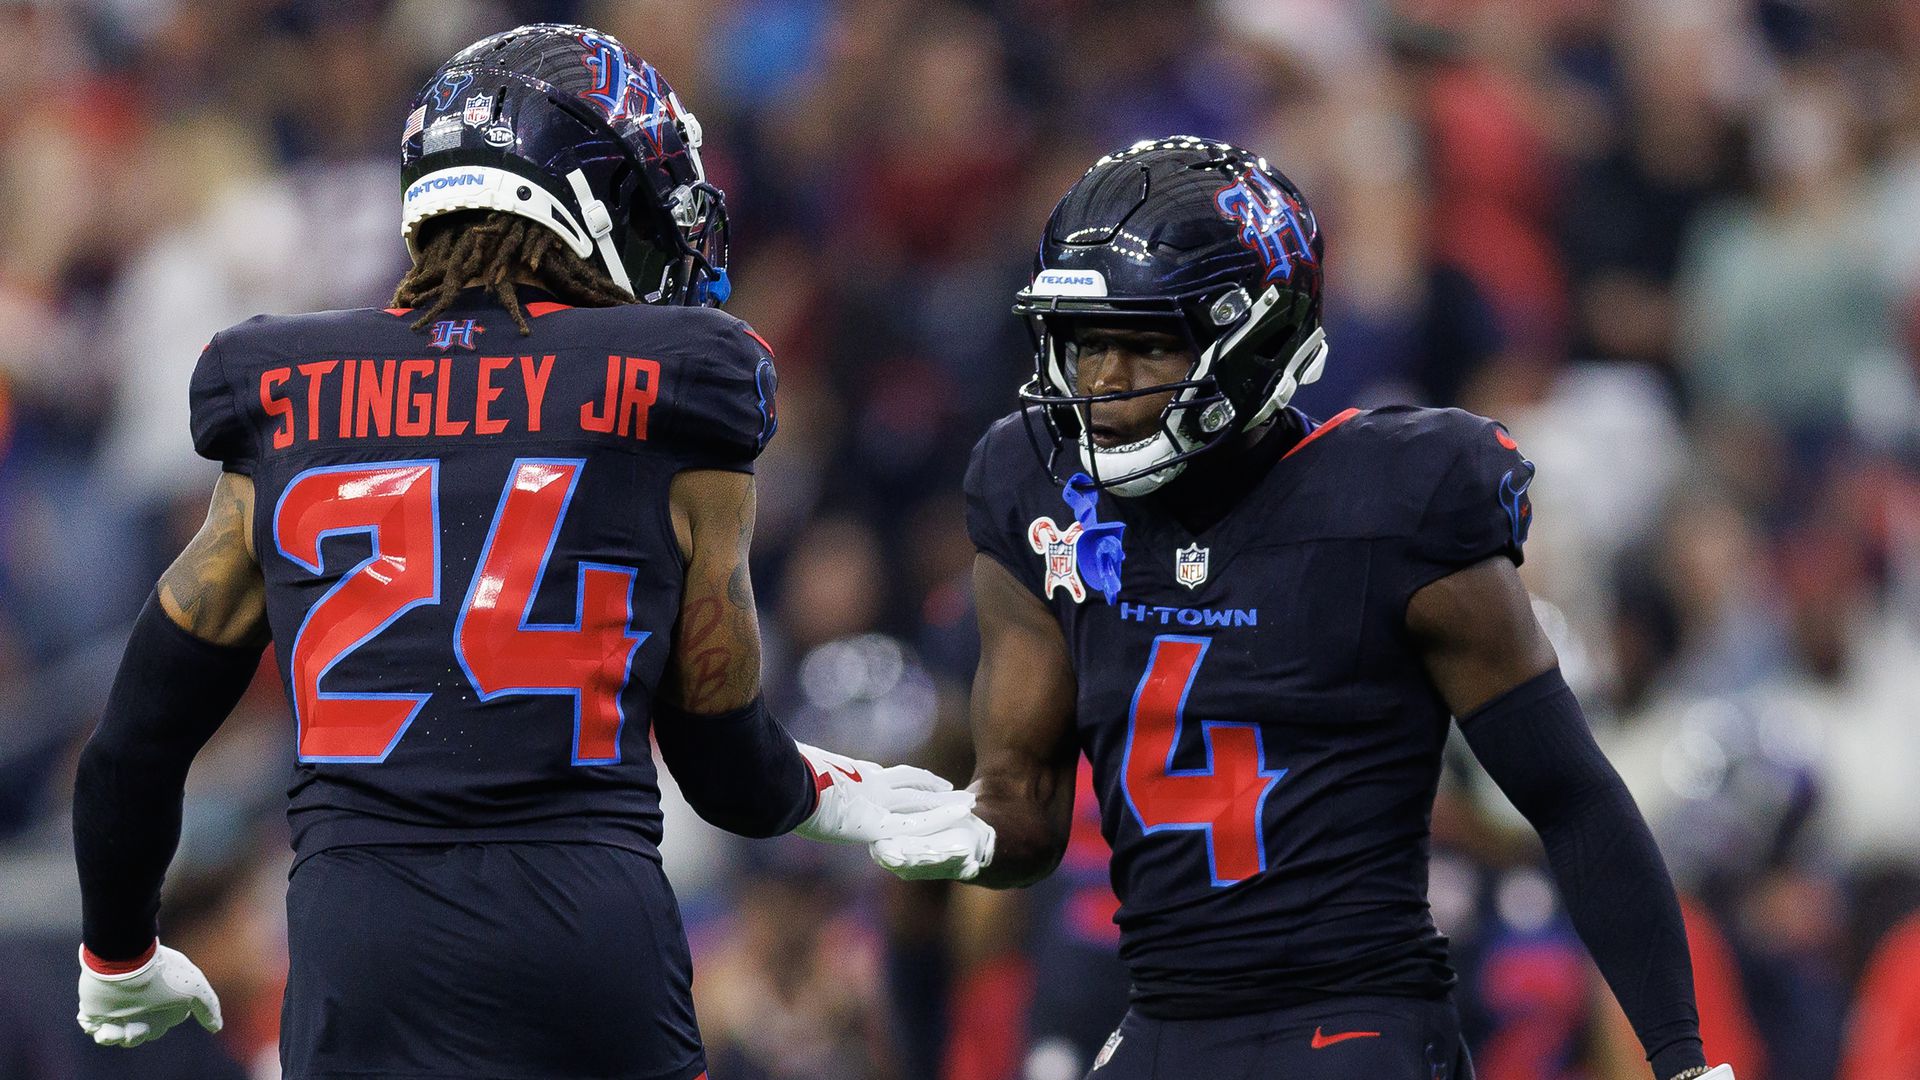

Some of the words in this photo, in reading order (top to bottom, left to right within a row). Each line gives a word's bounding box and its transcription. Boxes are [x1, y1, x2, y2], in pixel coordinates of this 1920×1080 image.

[1040, 275, 1094, 286] TEXANS
[260, 355, 556, 450] STINGLEY
[580, 355, 661, 441] JR
[1051, 556, 1072, 575] NFL
[1181, 563, 1203, 581] NFL
[273, 458, 651, 766] 24
[1120, 602, 1258, 627] H-TOWN
[1120, 634, 1289, 887] 4
